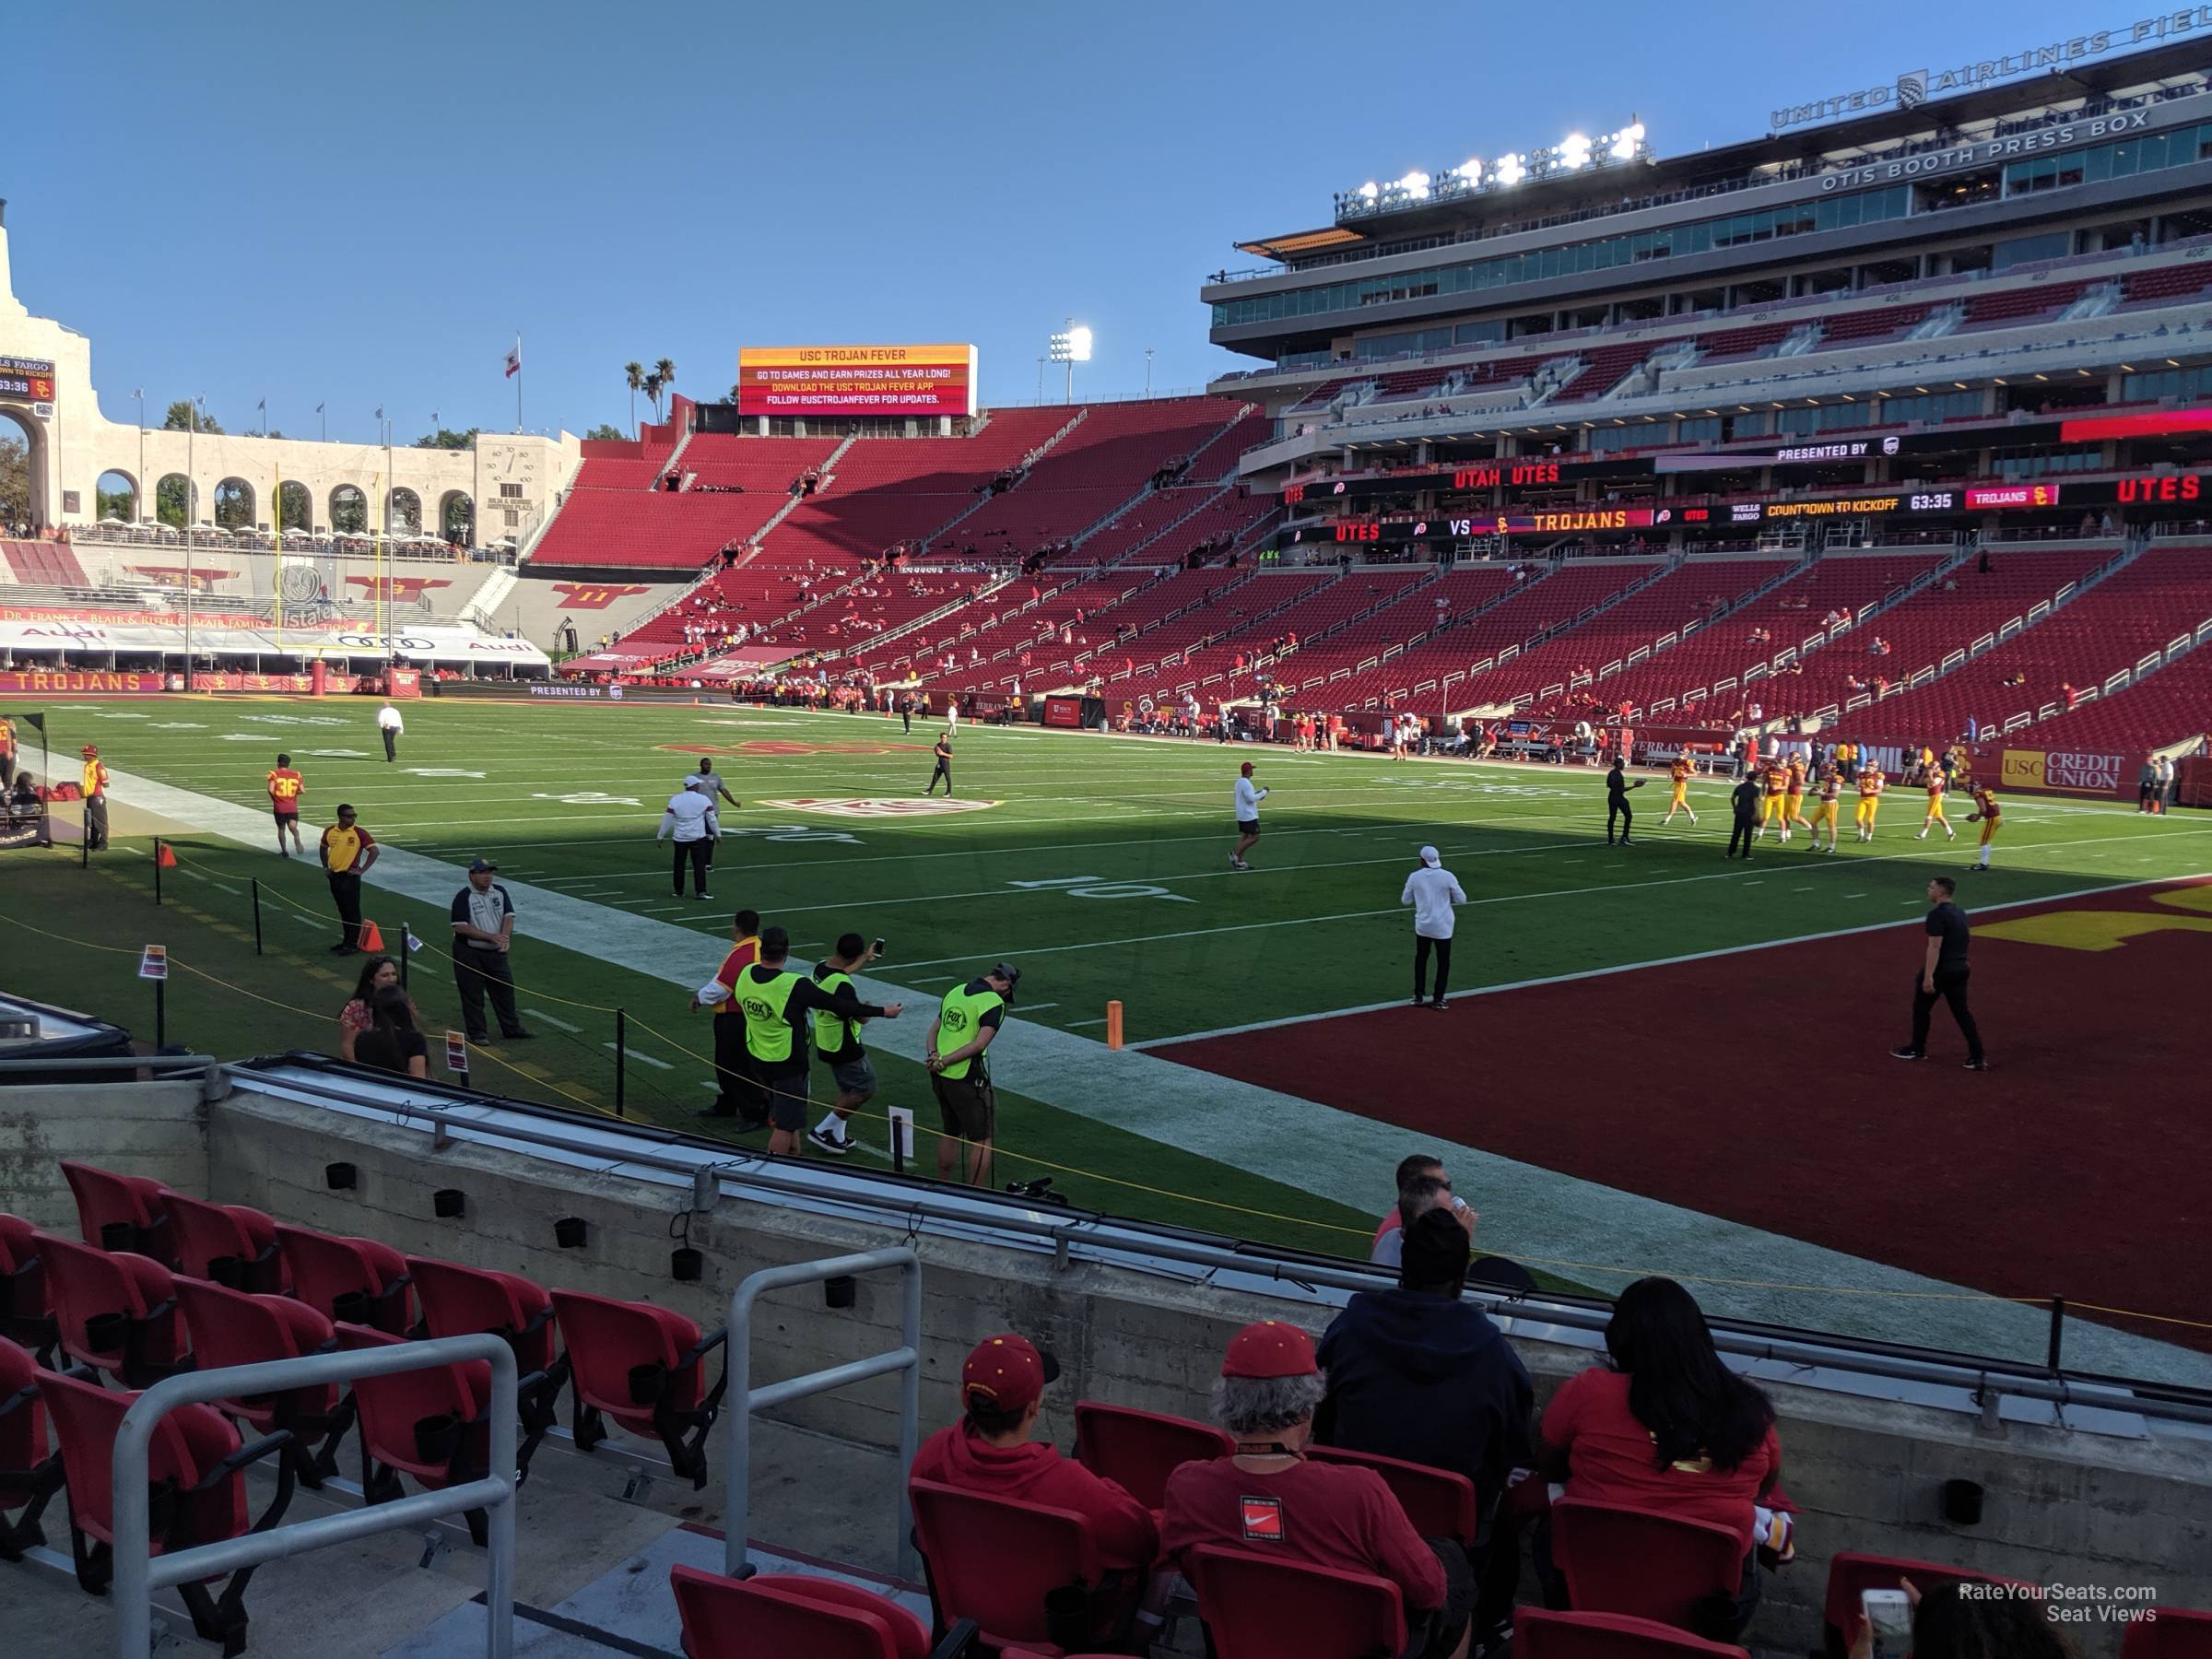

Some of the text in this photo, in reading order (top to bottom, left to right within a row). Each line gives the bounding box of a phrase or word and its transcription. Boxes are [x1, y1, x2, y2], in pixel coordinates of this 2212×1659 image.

[1771, 86, 1889, 128] UNITED
[1935, 30, 2111, 91] AIRLINES
[1821, 111, 2147, 191] OTIS BOOTH PRESS BOX
[799, 349, 906, 361] USC TROJAN FEVER
[14, 360, 49, 371] FARGO
[757, 369, 950, 380] GO TO GAMES AND EARN PRIZES ALL YEAR LONG!
[772, 382, 935, 392] DOWNLOAD THE USC TROJAN FEVER APP.
[767, 394, 939, 405] FOLLOW @USCTROJANFEVER FOR UPDATES.
[1778, 443, 1868, 461] PRESENTED BY
[1454, 464, 1560, 488] UTAH UTES
[1285, 485, 1303, 504] UTES
[2117, 475, 2201, 503] UTES
[1911, 493, 1952, 510] 63:35
[1974, 491, 2027, 504] TROJANS
[1684, 510, 1708, 521] UTES
[1732, 504, 1760, 512] WELLS
[1768, 499, 1900, 517] COUNTDOWN TO KICKOFF
[1534, 510, 1627, 532] TROJANS
[1732, 512, 1760, 521] FARGO
[1336, 523, 1380, 542] UTES
[1450, 519, 1470, 535] VS
[91, 614, 124, 625] BLAIR
[21, 628, 106, 638] Audi
[468, 642, 534, 652] Audi
[15, 673, 141, 690] TROJANS
[531, 686, 601, 697] PRESENTED BY
[2005, 759, 2043, 776] USC
[2046, 752, 2125, 772] CREDIT
[2046, 768, 2119, 789] UNION
[276, 777, 300, 797] 36
[747, 1000, 765, 1014] FOX
[947, 1010, 961, 1023] FOX
